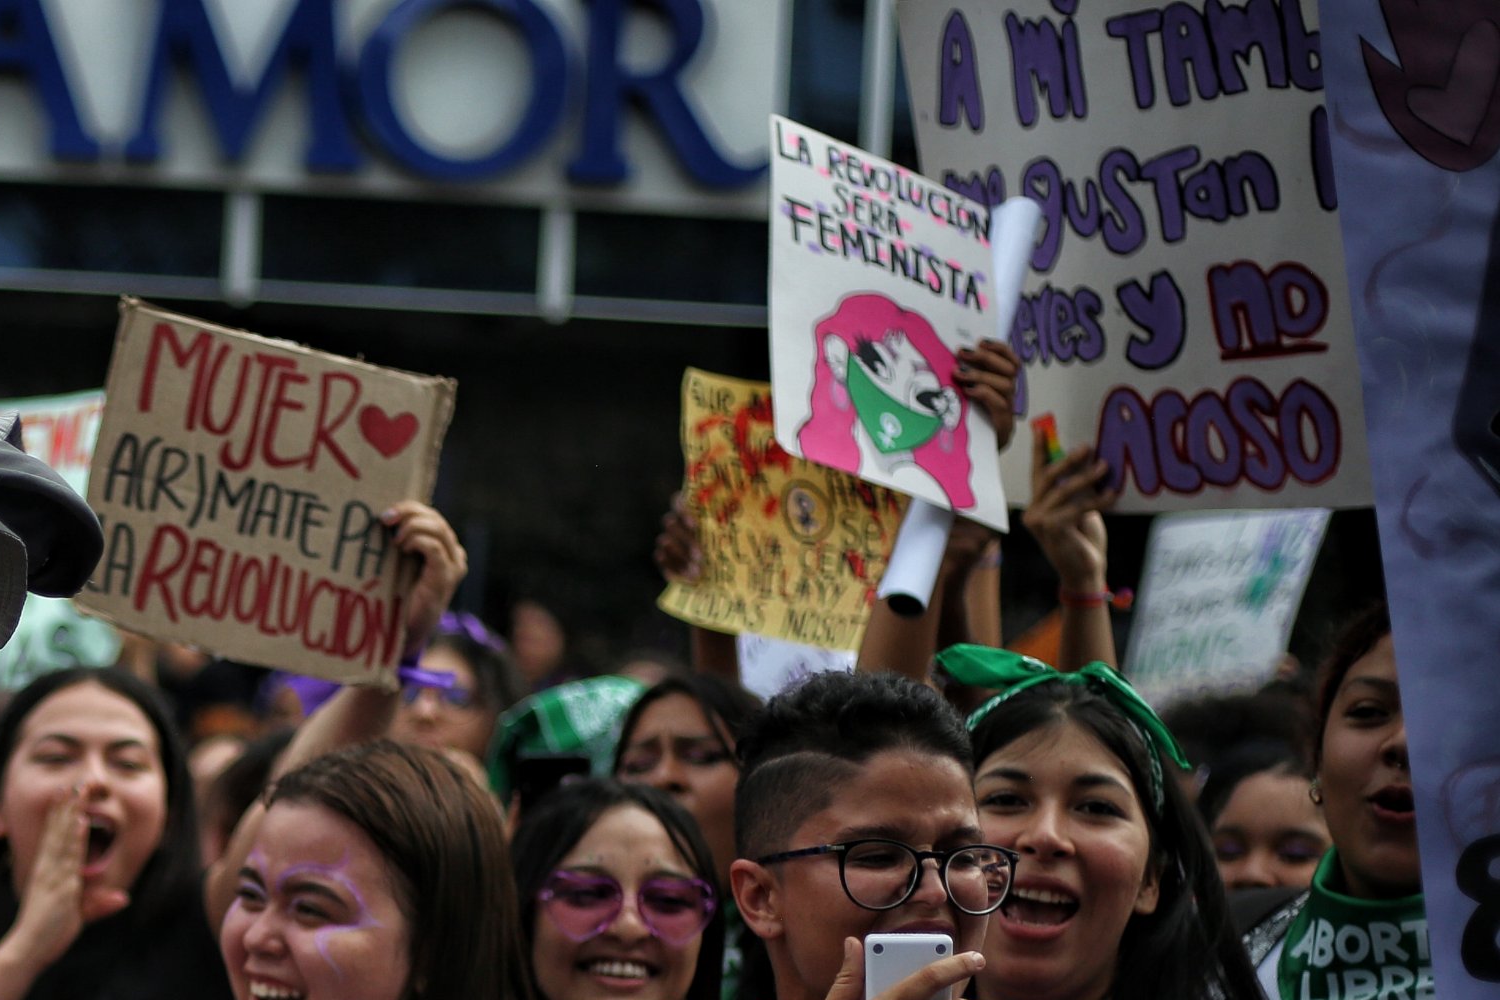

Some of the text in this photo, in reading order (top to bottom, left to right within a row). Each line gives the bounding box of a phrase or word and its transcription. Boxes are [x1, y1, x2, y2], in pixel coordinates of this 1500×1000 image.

[775, 121, 812, 167] LA
[783, 194, 984, 313] FEMINISTA
[138, 321, 362, 481] MUJER
[1098, 377, 1342, 496] ACOSO
